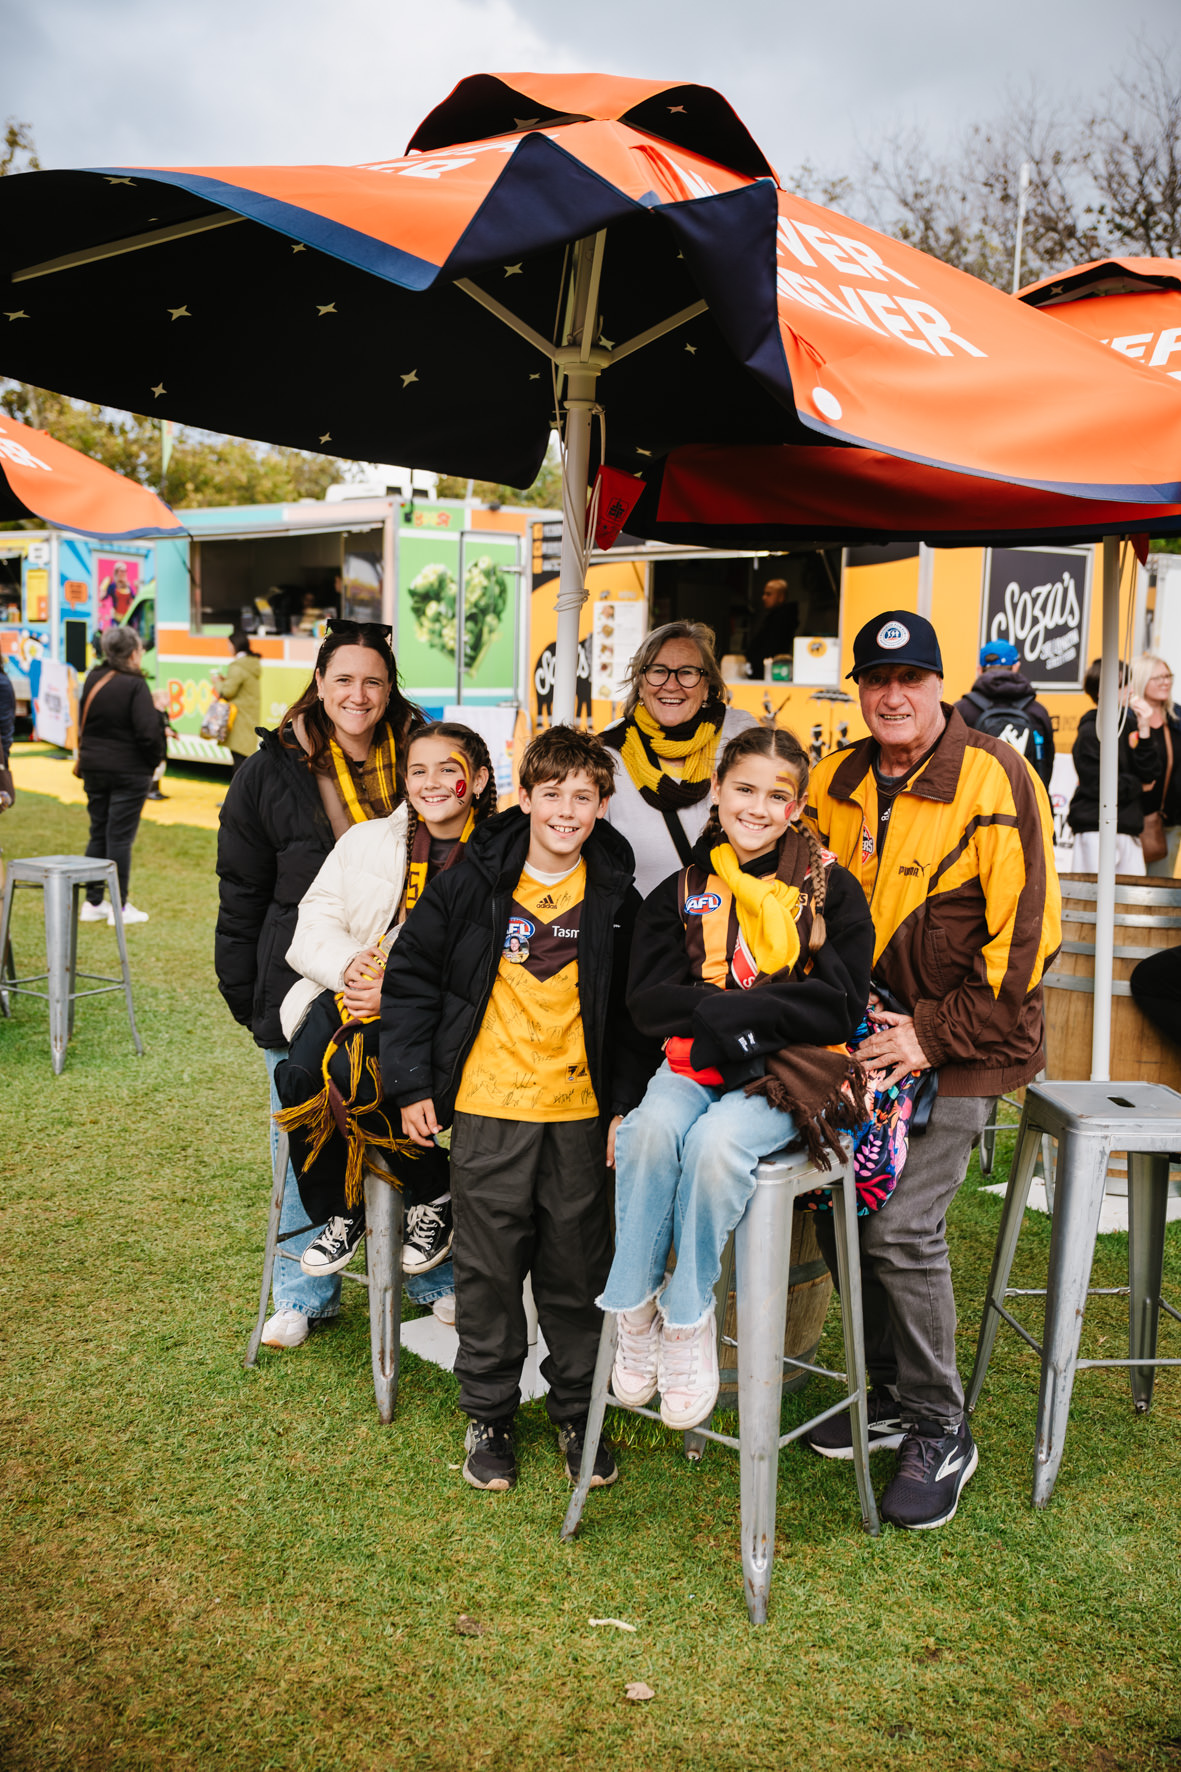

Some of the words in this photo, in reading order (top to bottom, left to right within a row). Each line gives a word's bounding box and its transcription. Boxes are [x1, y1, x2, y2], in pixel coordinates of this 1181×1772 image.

[991, 571, 1080, 662] Soza's
[167, 679, 220, 721] BOO
[898, 866, 919, 877] PUMA
[687, 896, 719, 911] AFL
[506, 923, 531, 936] FL
